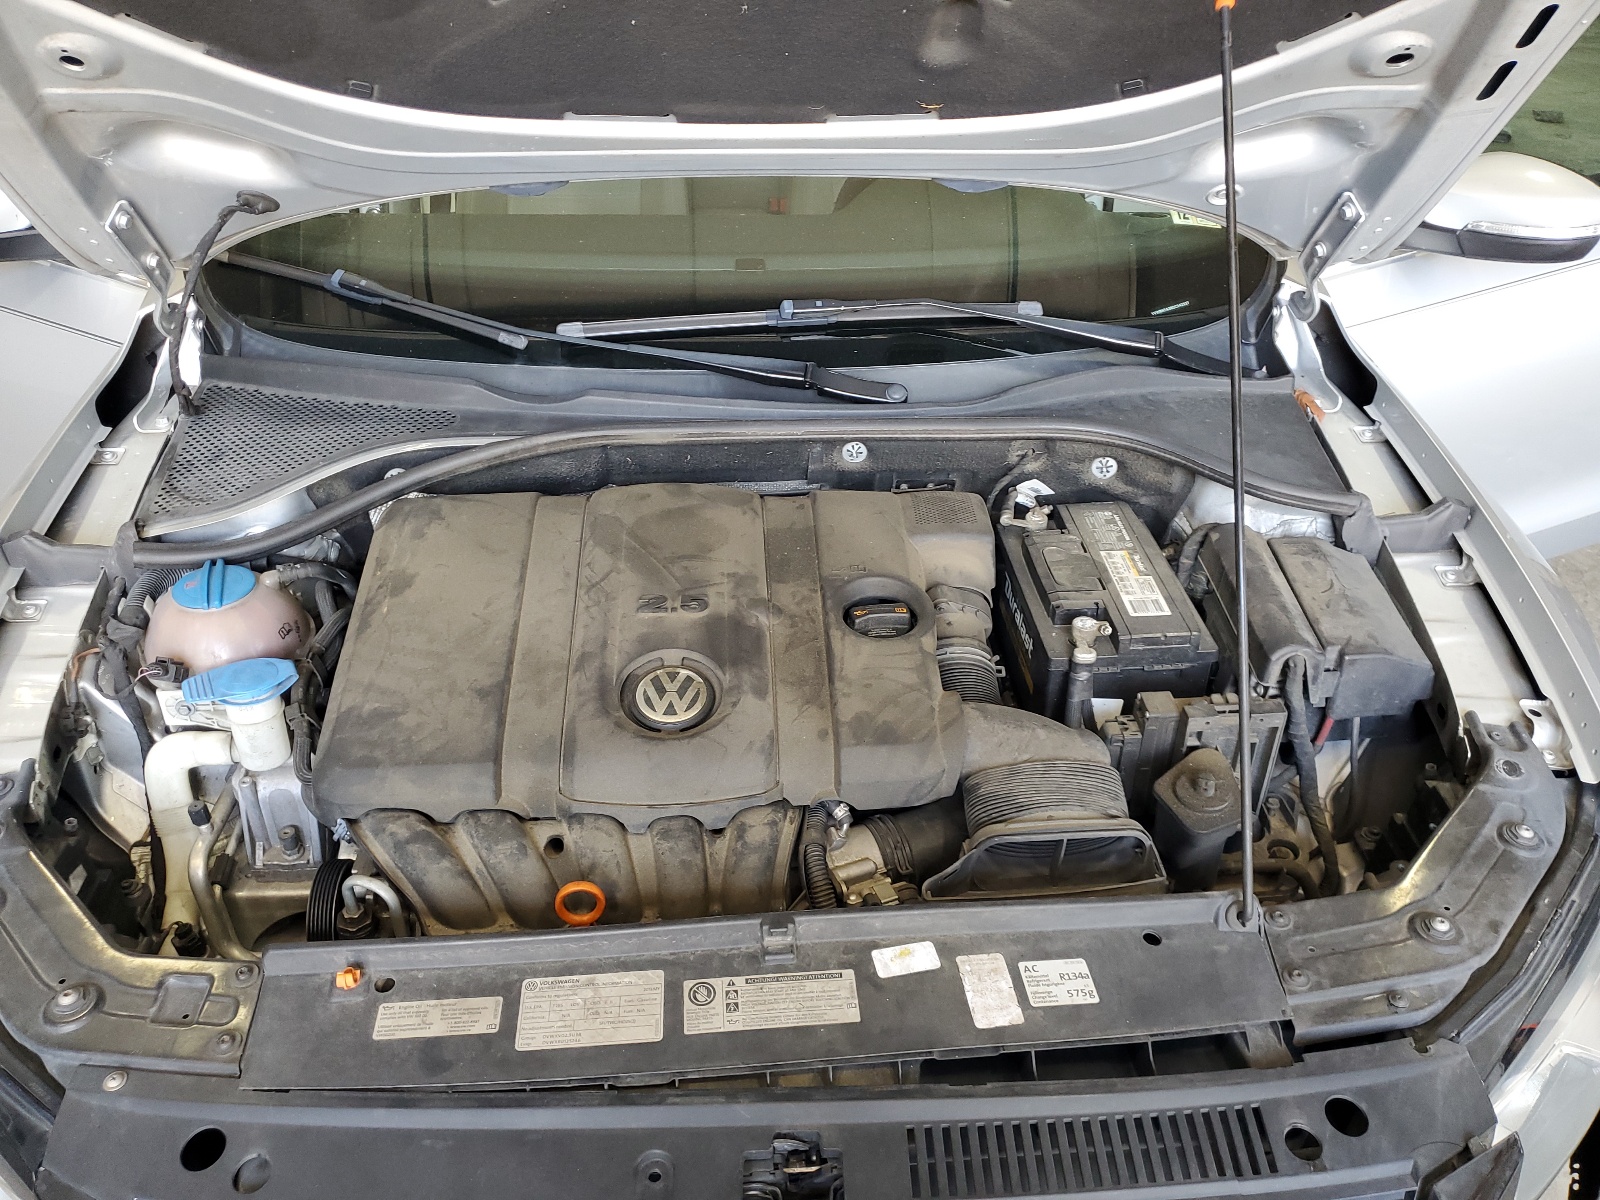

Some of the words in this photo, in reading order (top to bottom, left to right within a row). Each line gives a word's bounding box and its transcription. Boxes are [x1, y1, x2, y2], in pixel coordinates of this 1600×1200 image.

[637, 593, 709, 614] 2.5
[1004, 571, 1034, 659] Duralast
[636, 668, 707, 723] VW
[1024, 964, 1039, 974] AC
[539, 978, 580, 986] VOLKSWAGEN
[1058, 972, 1090, 981] R134a
[1067, 988, 1096, 999] 575g
